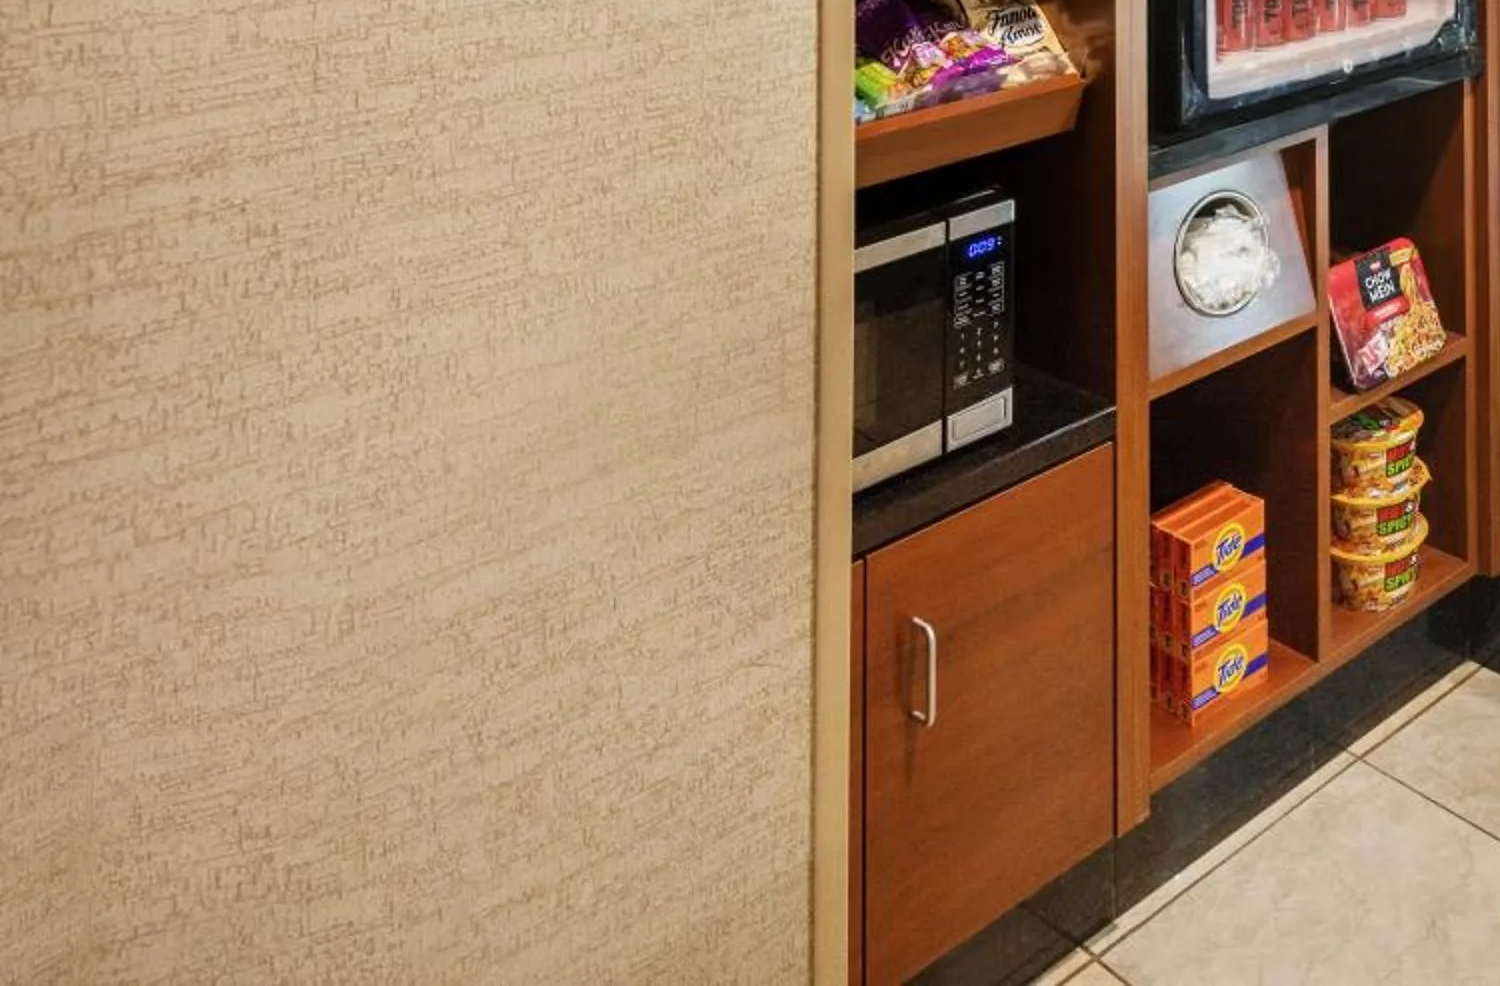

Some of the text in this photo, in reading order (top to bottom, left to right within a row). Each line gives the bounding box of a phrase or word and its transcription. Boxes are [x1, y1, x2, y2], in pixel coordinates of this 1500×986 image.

[1368, 280, 1396, 303] MEIN
[1216, 533, 1242, 565] Tide
[1217, 593, 1243, 626] Tide
[1218, 654, 1245, 687] Tide
